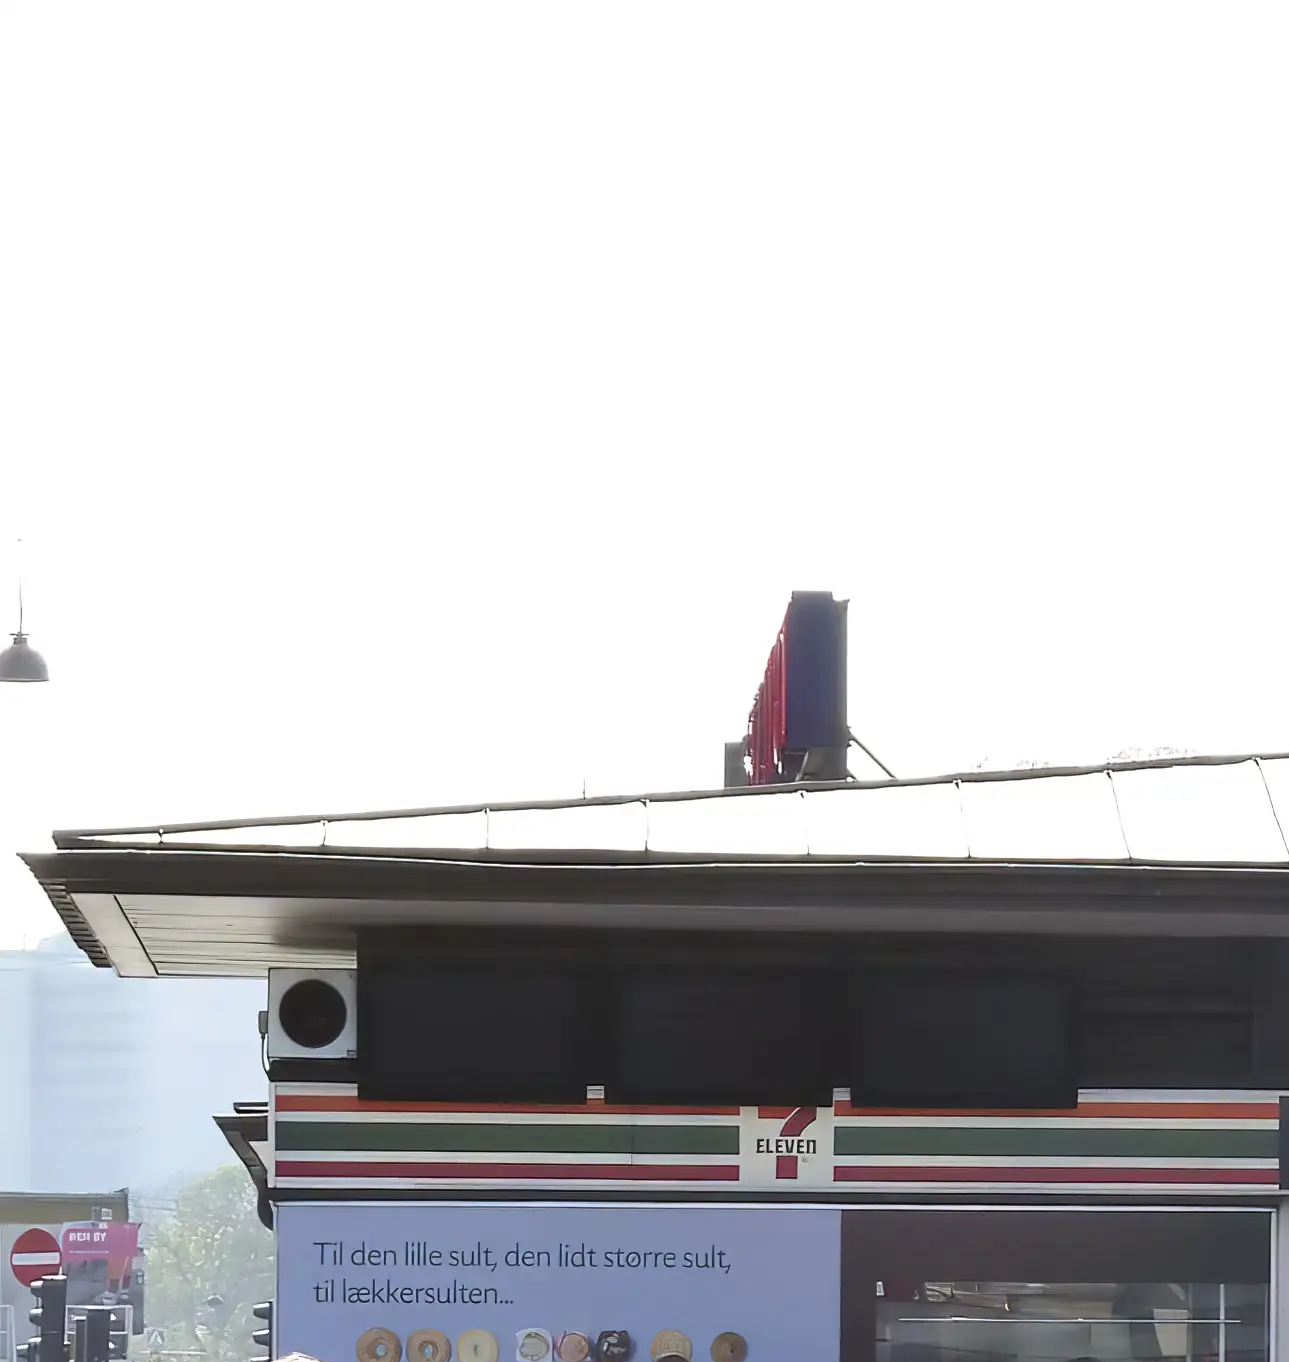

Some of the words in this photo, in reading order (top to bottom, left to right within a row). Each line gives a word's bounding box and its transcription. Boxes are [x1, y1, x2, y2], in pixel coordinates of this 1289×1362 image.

[313, 1241, 343, 1266] Til
[351, 1241, 397, 1267] den
[405, 1241, 443, 1267] lille
[448, 1241, 498, 1273] sult,
[504, 1243, 551, 1268] den
[558, 1243, 598, 1268] lidt
[604, 1248, 677, 1269] større
[682, 1244, 732, 1275] sult,
[313, 1279, 335, 1304] til
